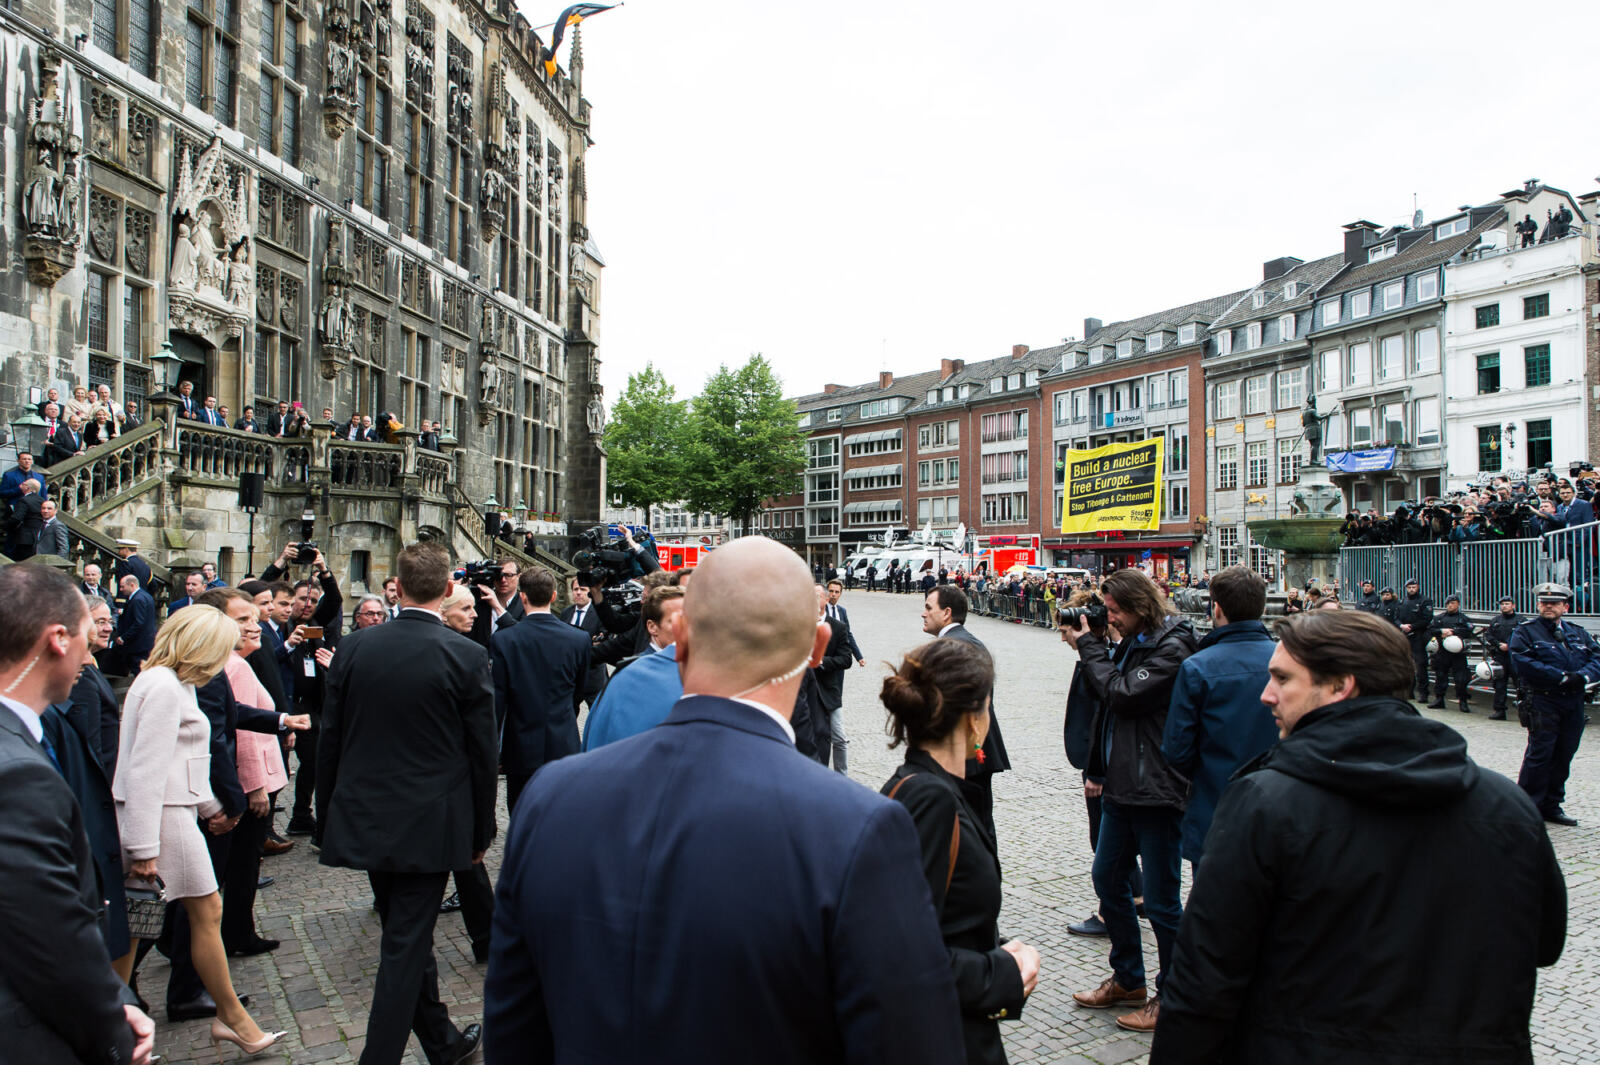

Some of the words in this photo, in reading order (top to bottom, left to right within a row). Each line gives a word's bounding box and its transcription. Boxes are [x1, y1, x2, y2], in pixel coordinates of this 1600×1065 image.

[1074, 463, 1100, 477] Build
[1104, 462, 1110, 472] a
[1113, 450, 1150, 468] nuclear
[1072, 482, 1092, 495] free
[1095, 474, 1132, 490] Europe.
[1072, 501, 1085, 512] Stop
[1116, 490, 1152, 502] Cattenom!
